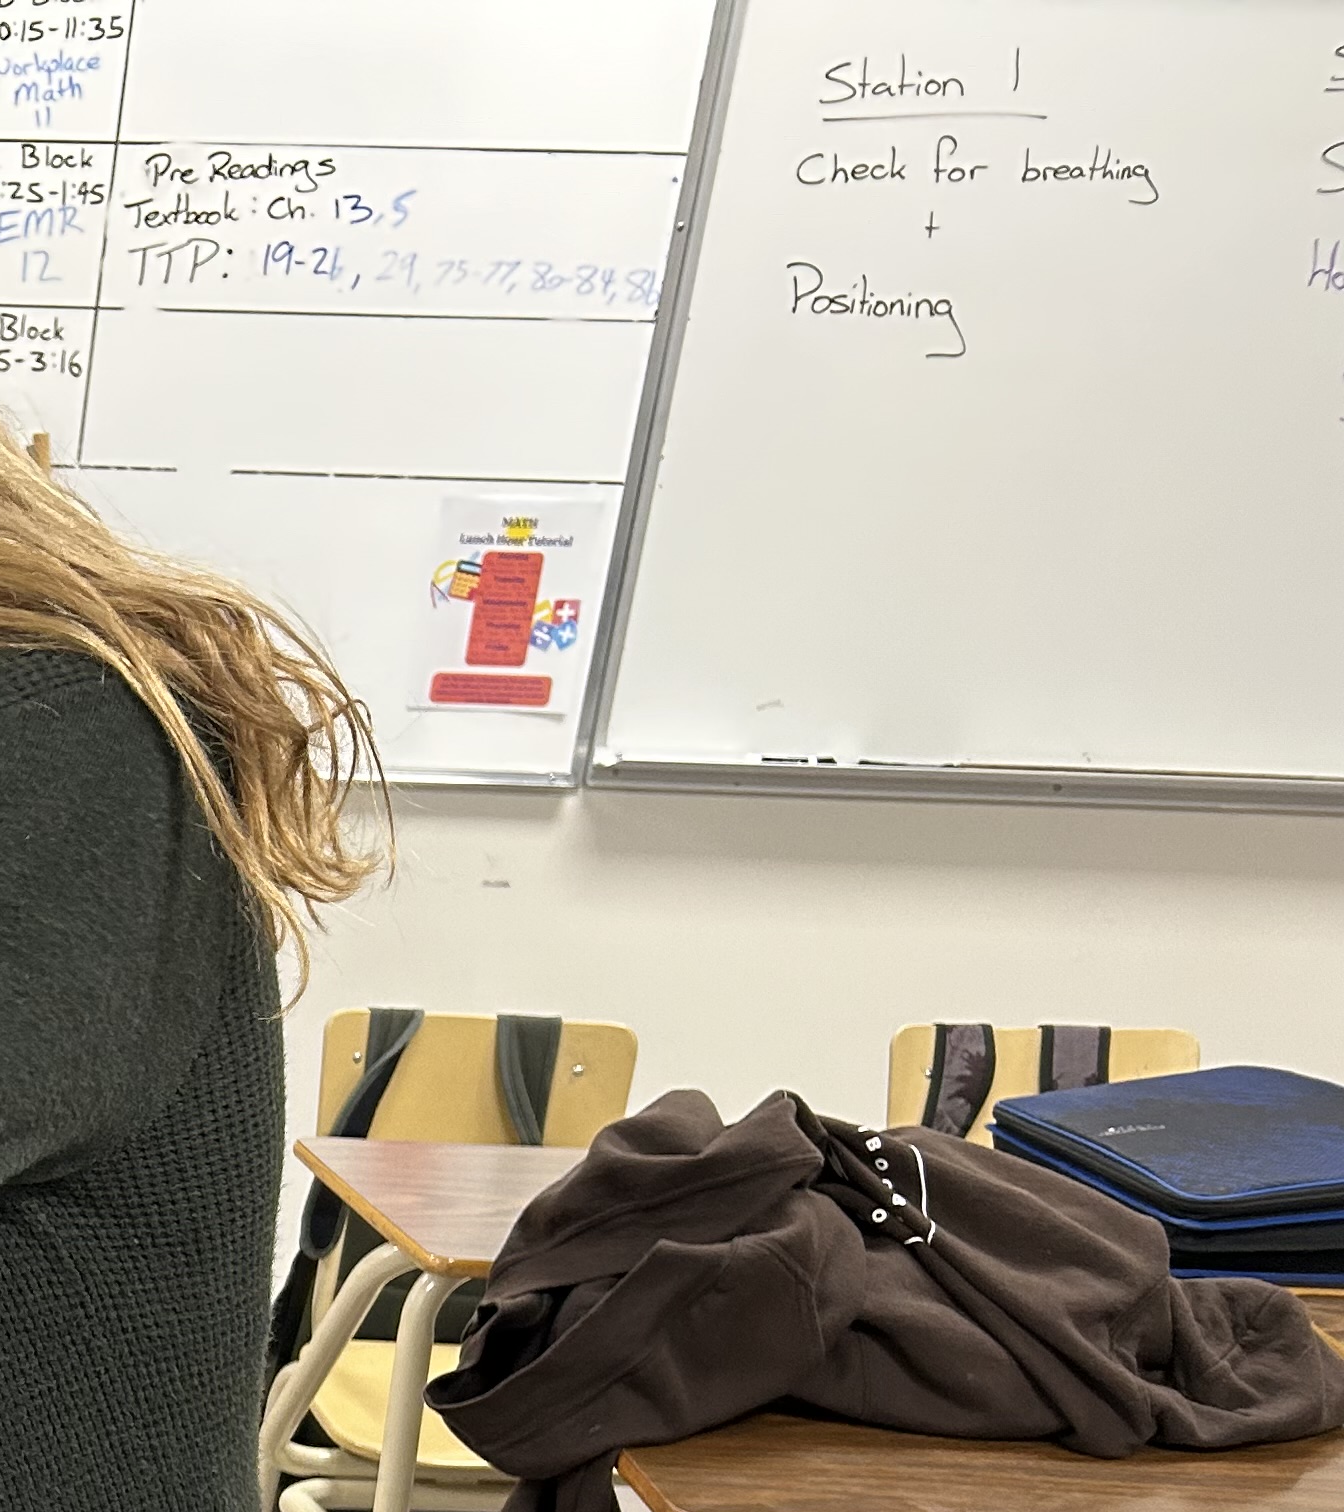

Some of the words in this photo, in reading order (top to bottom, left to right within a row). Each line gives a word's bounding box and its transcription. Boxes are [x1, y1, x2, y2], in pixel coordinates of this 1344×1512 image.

[14, 76, 83, 106] Math
[819, 51, 966, 105] Station
[1012, 47, 1022, 92] 1
[20, 144, 94, 170] Block
[145, 153, 199, 188] Pre
[209, 151, 336, 193] Readings
[796, 146, 907, 187] Check
[932, 134, 988, 185] for
[1021, 144, 1160, 206] breathing
[21, 250, 62, 283] 12
[786, 261, 967, 359] Positioning
[0, 313, 65, 342] Block
[501, 517, 539, 529] MATH
[459, 533, 494, 546] Lunch
[527, 535, 574, 548] Tutorial
